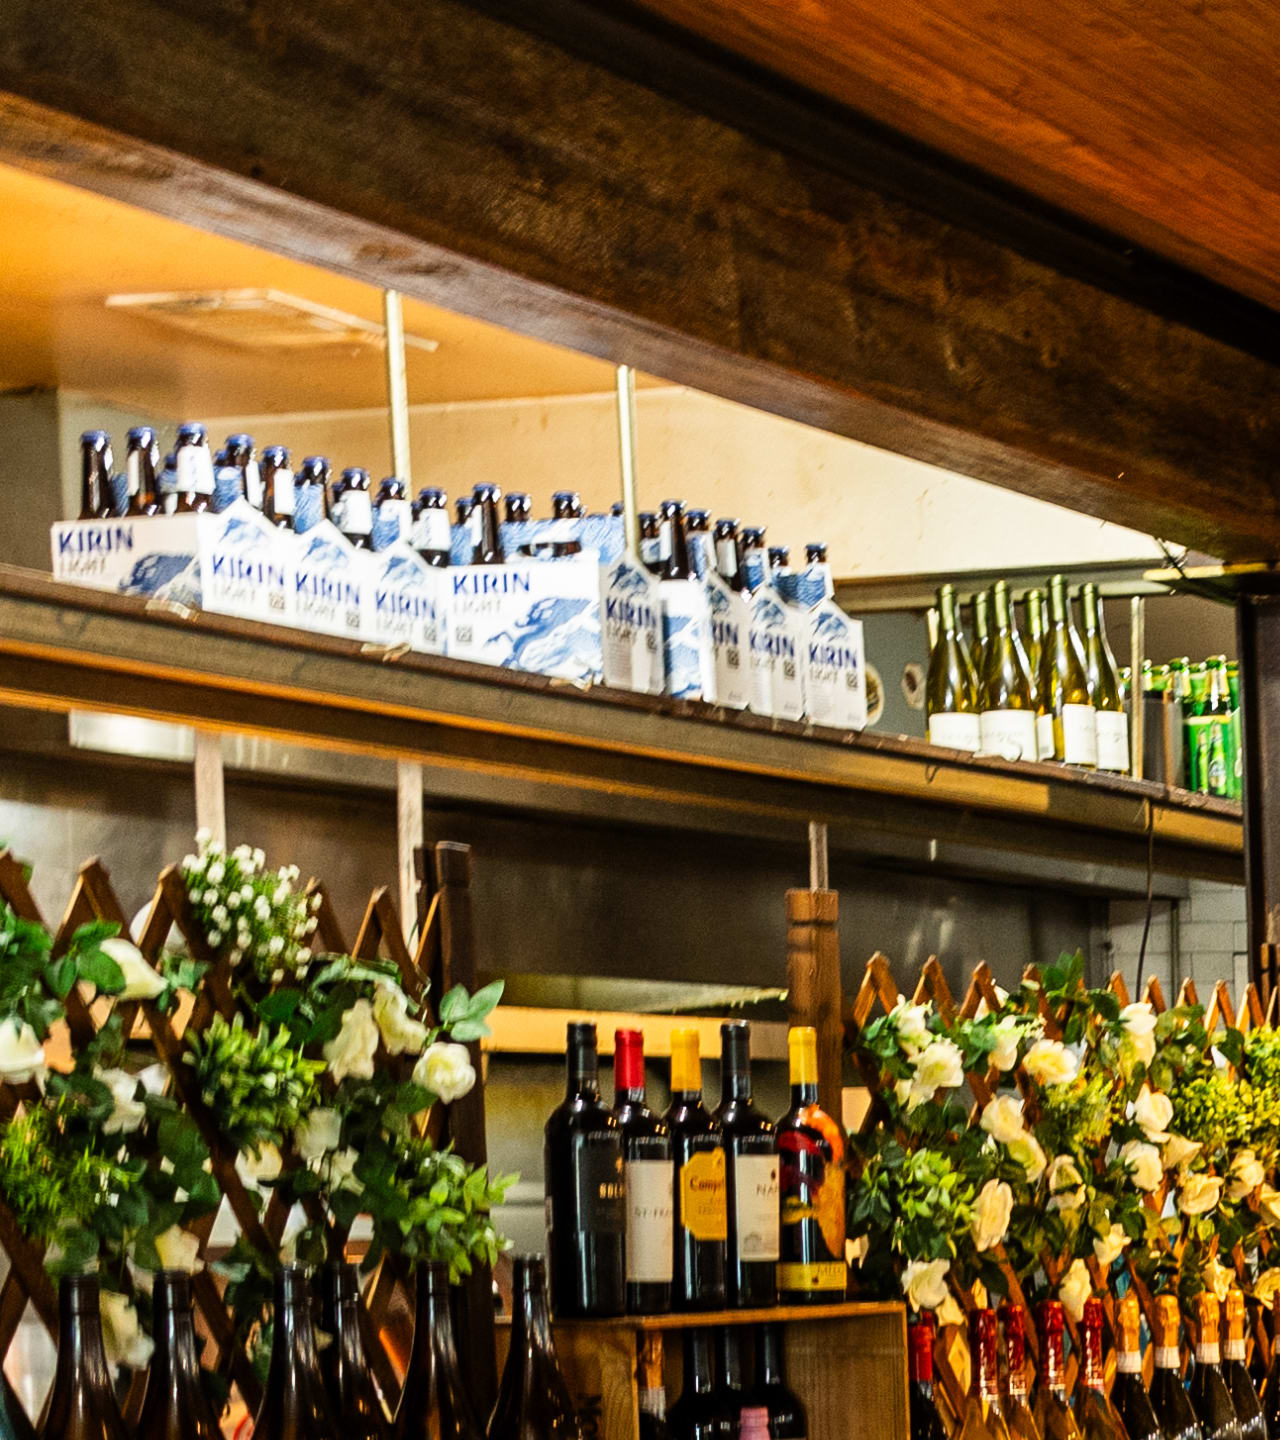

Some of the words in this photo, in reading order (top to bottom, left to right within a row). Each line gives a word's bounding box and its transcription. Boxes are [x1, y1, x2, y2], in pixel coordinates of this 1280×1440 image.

[58, 525, 134, 554] KIRIN
[213, 554, 285, 587] KIRIN
[453, 572, 530, 595] KIRIN
[296, 572, 360, 605] KIRIN
[375, 589, 436, 620] KIRIN
[605, 597, 659, 629] KIRIN
[808, 642, 858, 669] KIRIN
